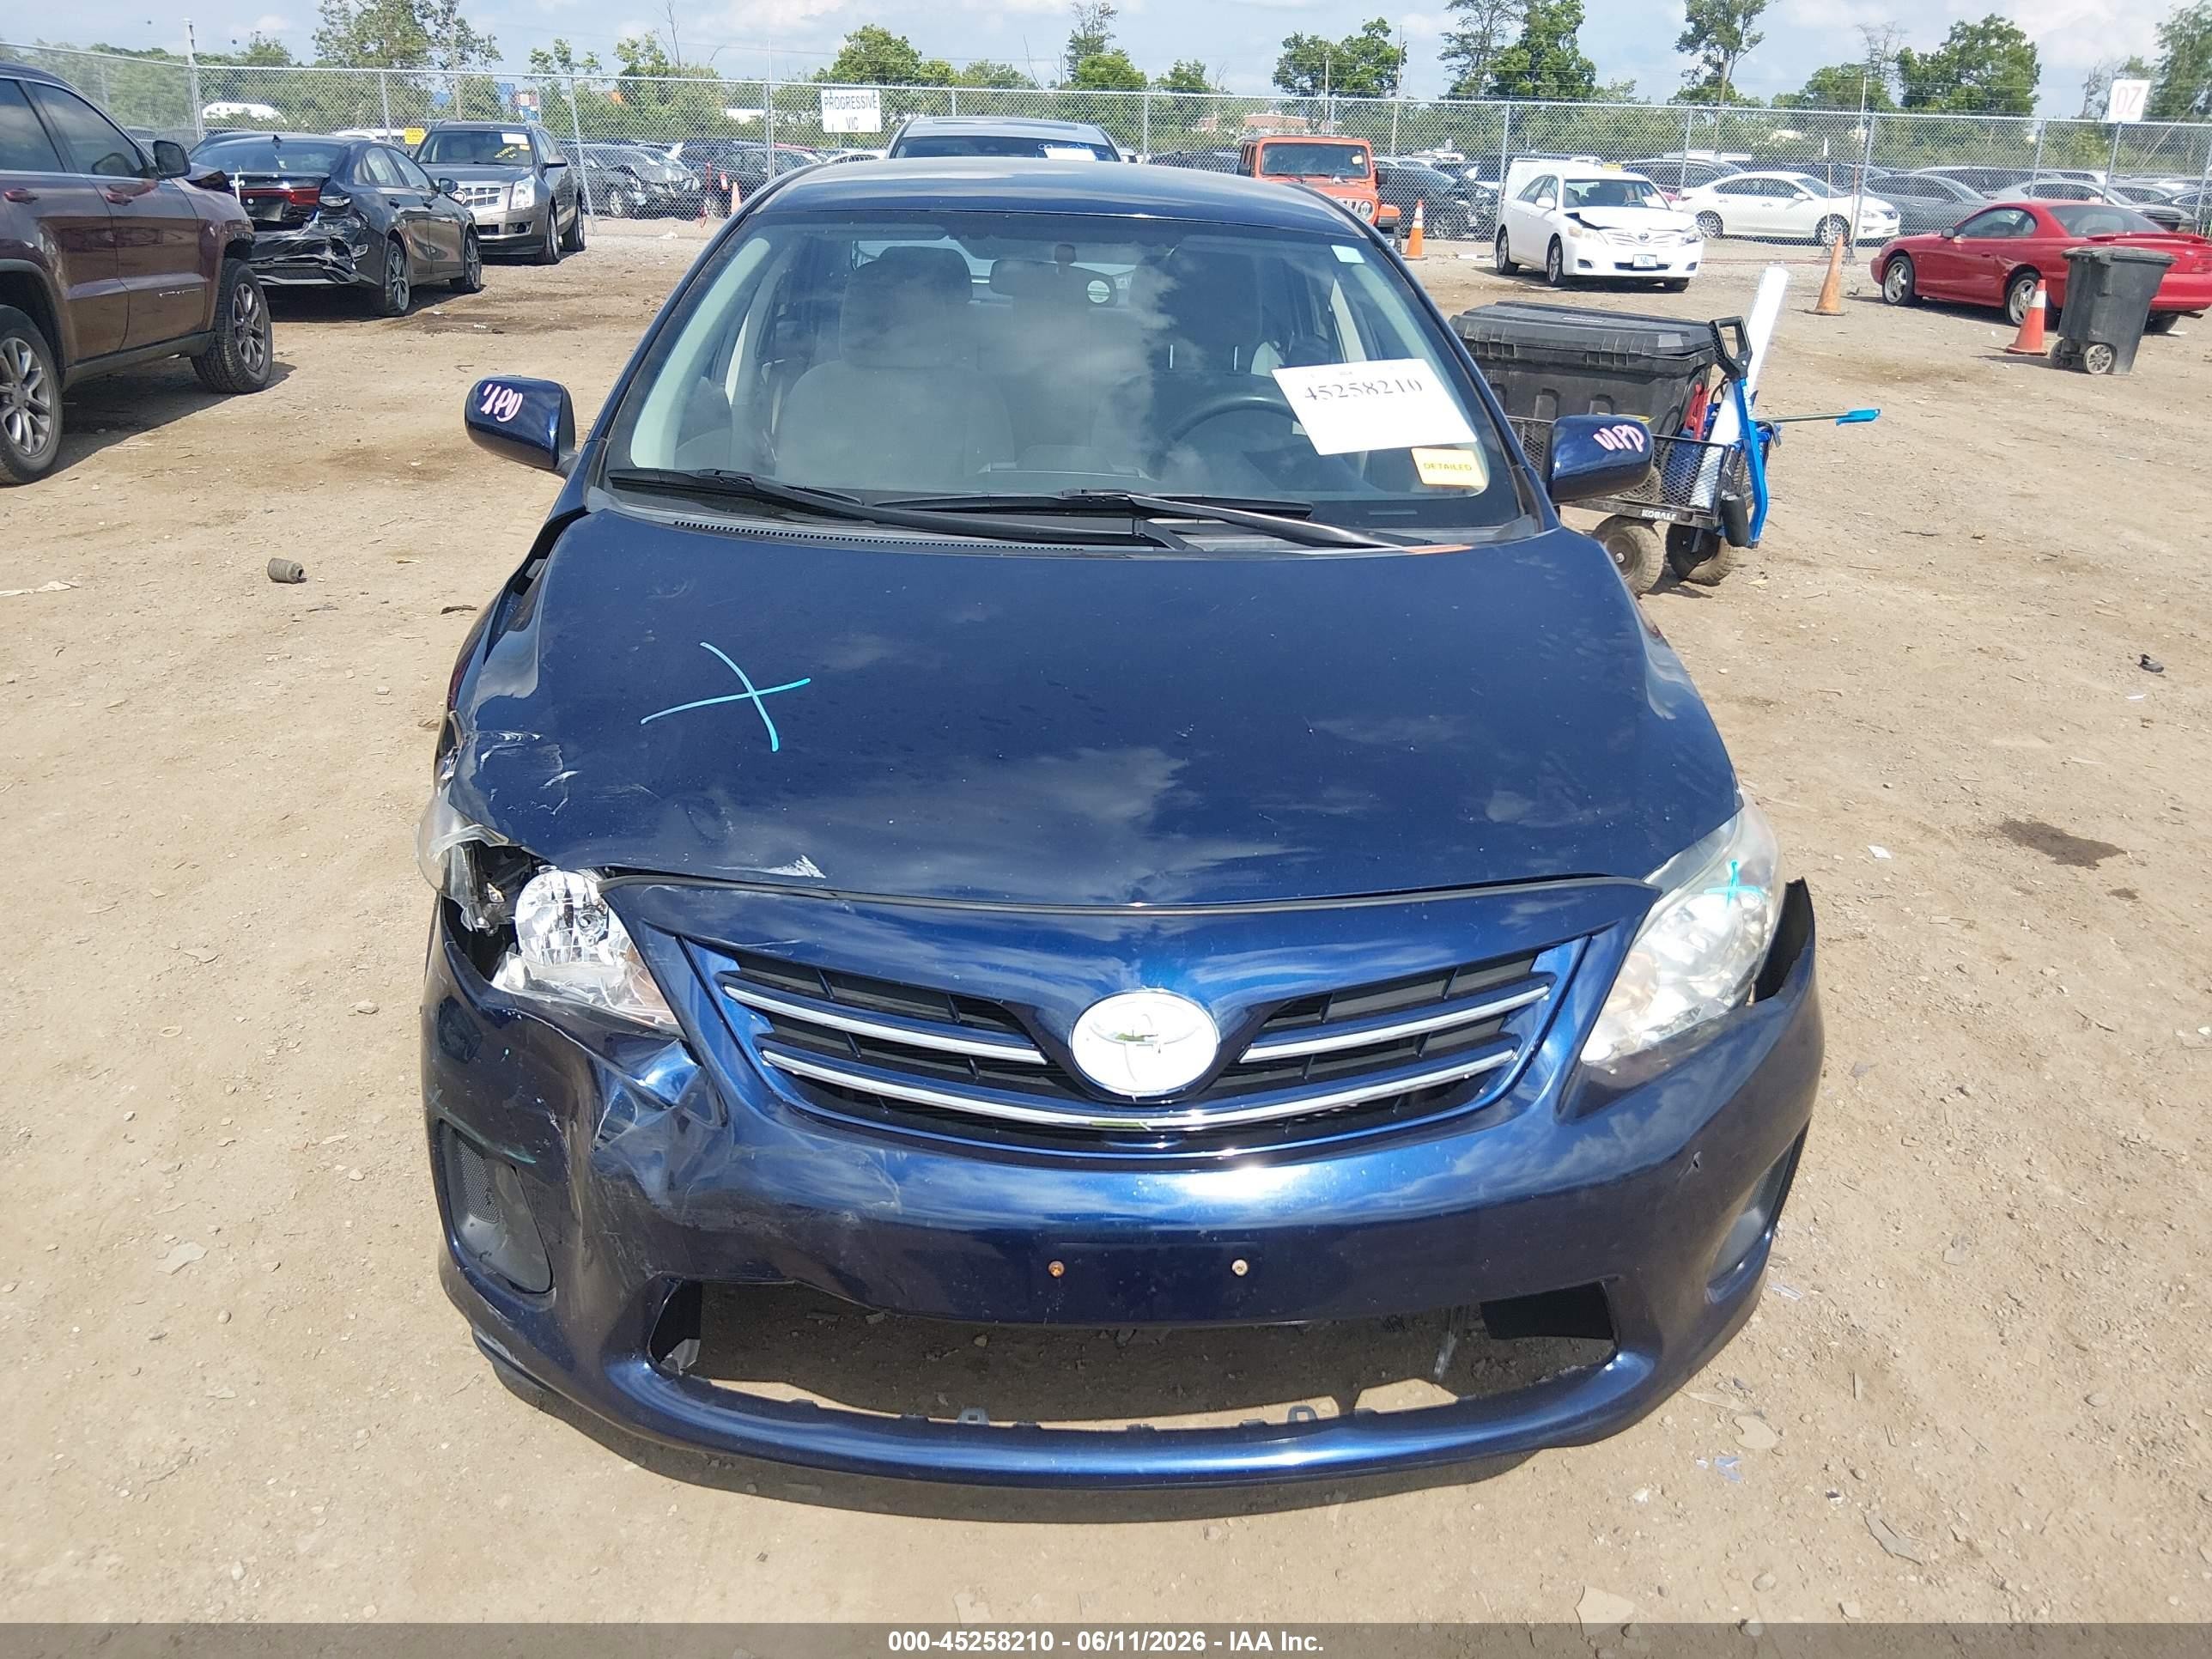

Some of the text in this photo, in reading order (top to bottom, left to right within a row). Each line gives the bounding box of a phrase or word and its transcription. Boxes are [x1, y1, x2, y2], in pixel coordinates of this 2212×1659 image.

[823, 95, 878, 110] PROGRESSIVE
[845, 116, 859, 131] VIC
[1304, 379, 1423, 400] 45258210
